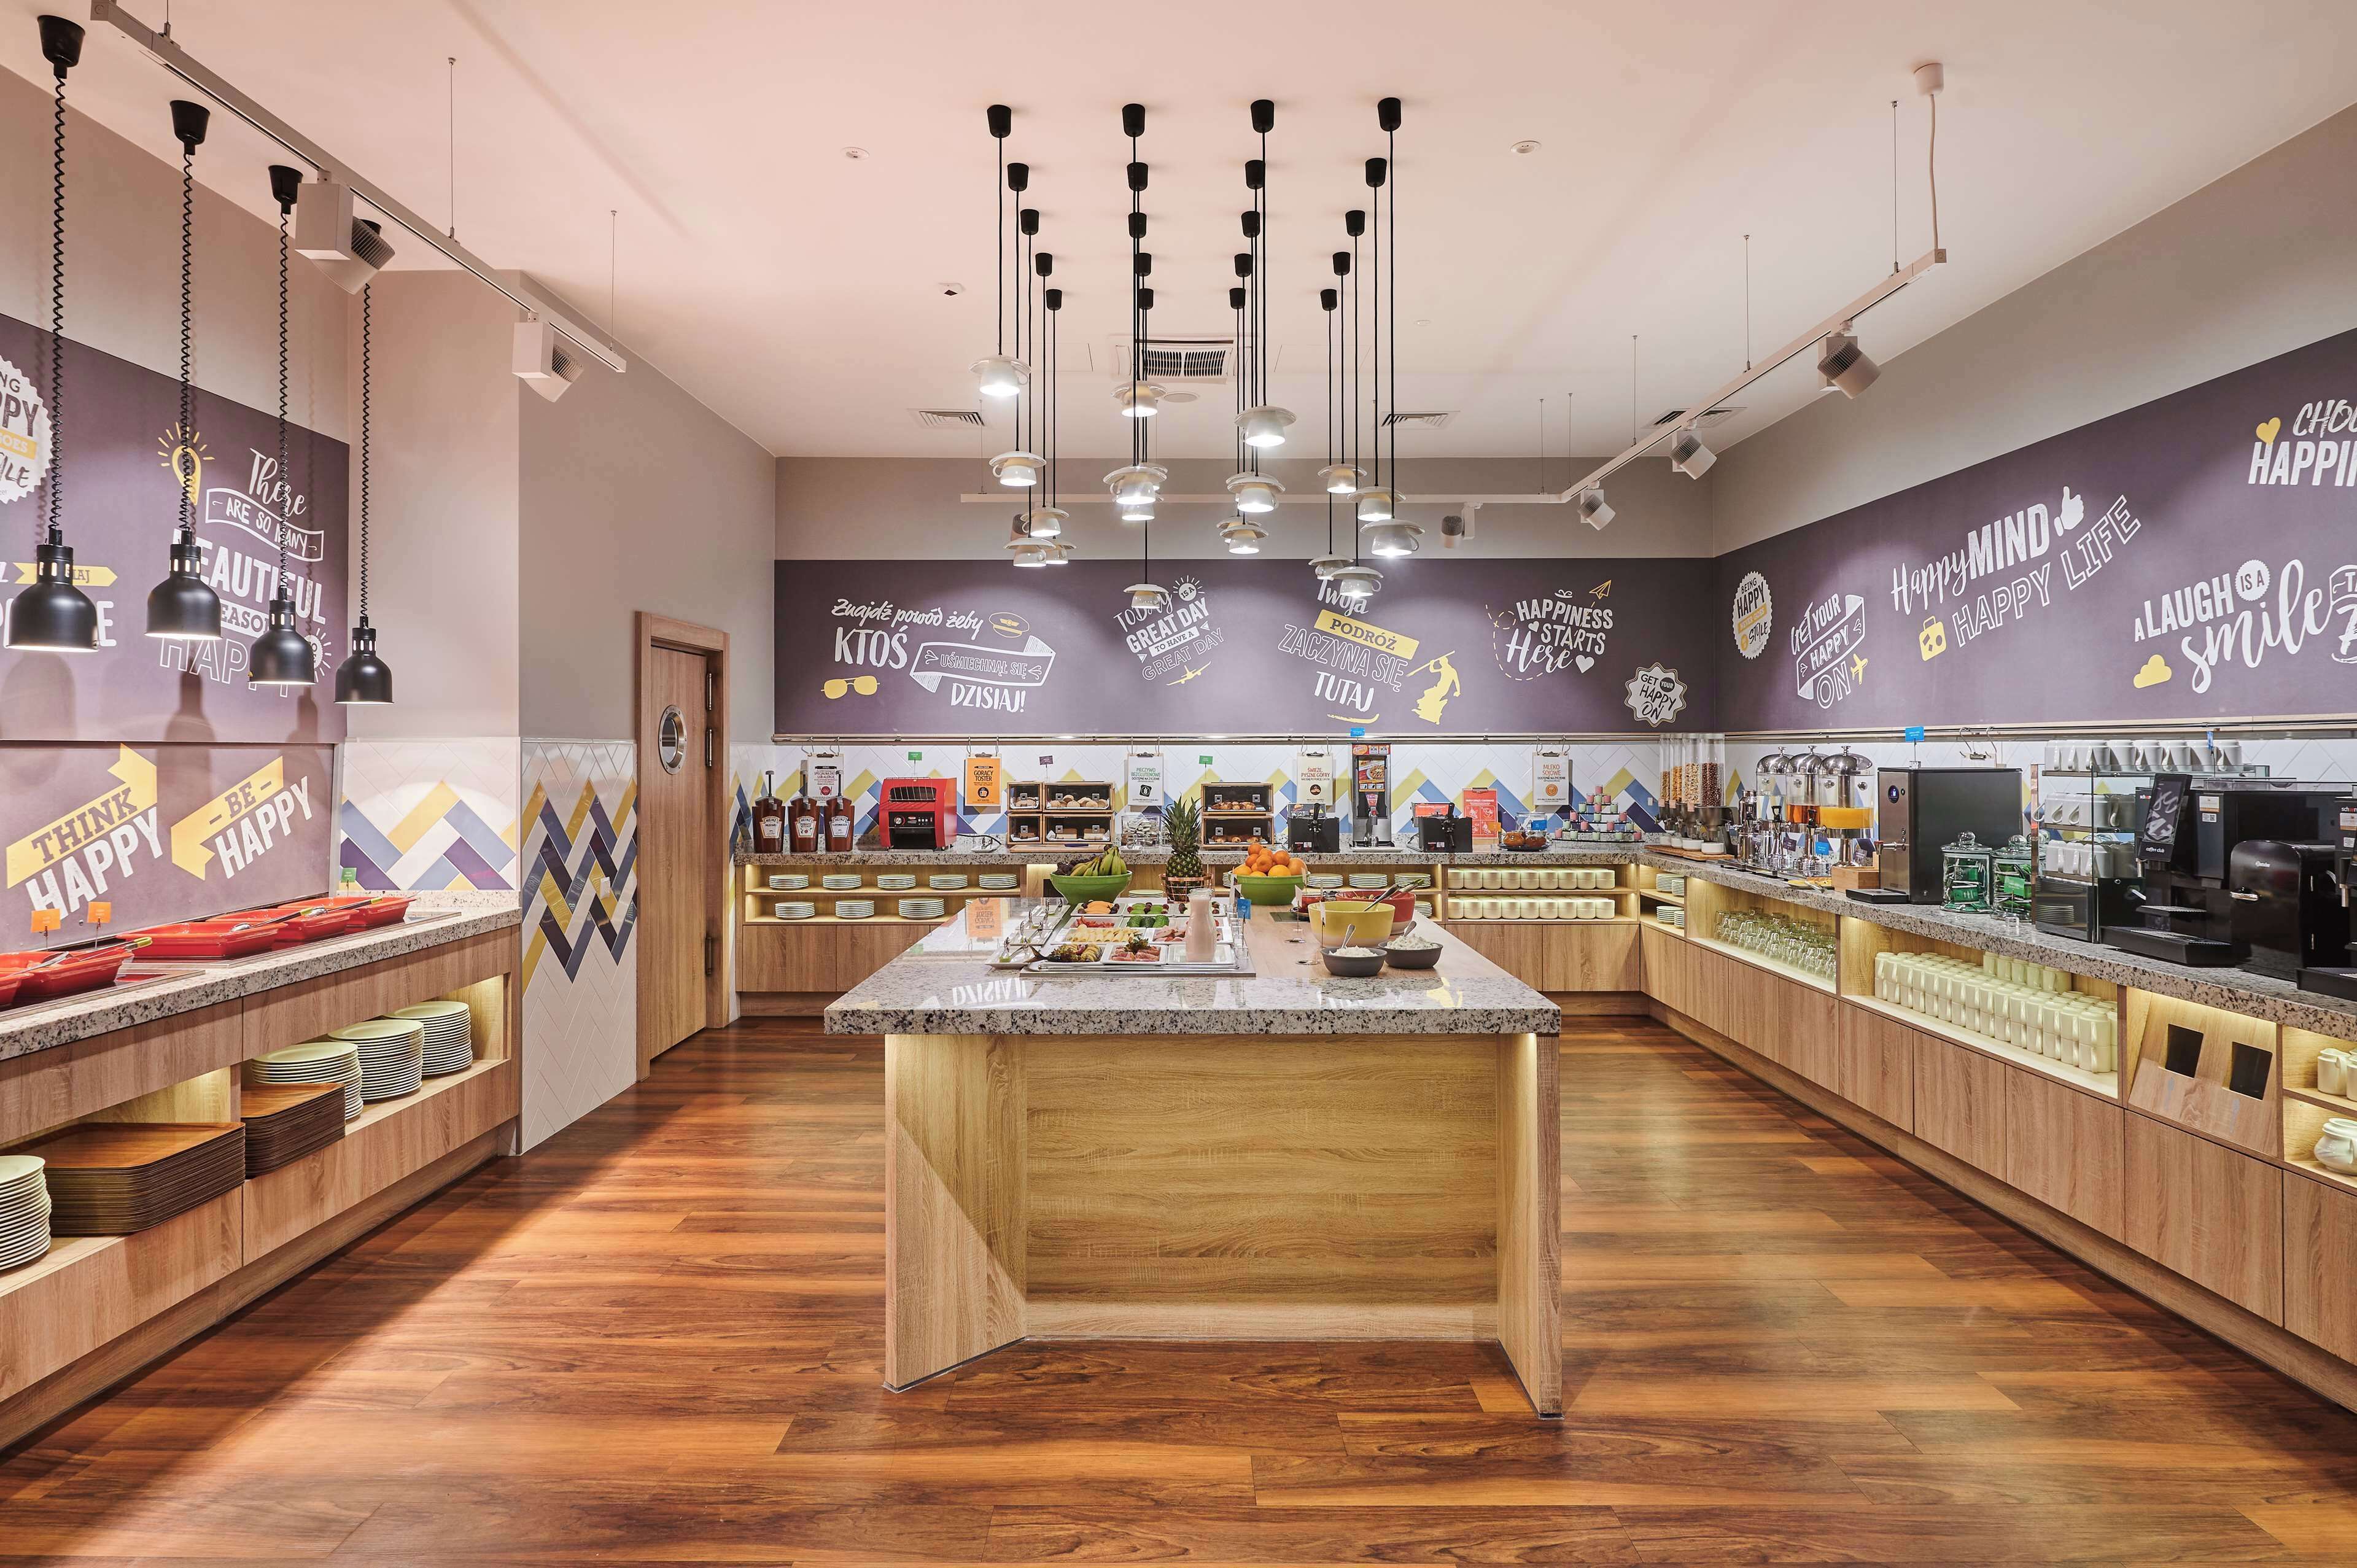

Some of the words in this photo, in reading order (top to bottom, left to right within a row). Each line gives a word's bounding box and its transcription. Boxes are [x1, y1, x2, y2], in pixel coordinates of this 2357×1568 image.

[0, 434, 28, 453] OES
[249, 447, 307, 517] There
[226, 498, 250, 525] ARE
[256, 510, 271, 532] SO
[274, 526, 308, 557] MANY
[173, 529, 326, 624] EAUTIFUL
[1891, 549, 1970, 615] Happy
[1967, 503, 2049, 580] MIND
[1953, 562, 2052, 647] HAPPY
[2061, 495, 2141, 590] LIFE
[1181, 589, 1188, 599] IS
[1737, 581, 1765, 619] HAPPY
[1741, 578, 1757, 594] BEING
[2240, 575, 2252, 592] IS
[2256, 570, 2265, 587] A
[832, 598, 894, 625] Znajdź
[892, 608, 944, 631] powód
[946, 609, 984, 640] żeby
[1126, 613, 1179, 653] GREAT
[1179, 597, 1210, 625] DAY
[1516, 599, 1613, 629] HAPPINESS
[1812, 593, 1842, 631] YOUR
[2135, 618, 2145, 642] A
[2145, 573, 2234, 638] LAUGH
[2181, 559, 2332, 693] smile
[834, 624, 908, 669] KTOŚ
[1142, 647, 1191, 681] GREAT
[1194, 627, 1225, 655] DAY
[1154, 643, 1165, 653] TO
[1167, 635, 1186, 649] HAVE
[1187, 631, 1195, 640] A
[1329, 618, 1399, 651] PODRÓŻ
[1505, 629, 1574, 673] Here
[1540, 624, 1606, 655] STARTS
[1749, 622, 1768, 645] STYLE
[1810, 625, 1850, 670] HAPPY
[160, 637, 288, 697] HAP
[941, 651, 1008, 677] UŚMIECHNĄŁ
[1010, 662, 1028, 679] SIĘ
[1278, 624, 1370, 675] ZACZYNA
[1372, 653, 1408, 693] SIĘ
[951, 683, 1027, 713] DZISIAJ!
[1314, 671, 1375, 712] TUTAJ
[1640, 686, 1677, 712] HAPPY
[1641, 674, 1659, 686] GET
[1660, 680, 1674, 690] YOUR
[1817, 661, 1852, 708] ON
[1641, 702, 1663, 720] ON
[225, 782, 256, 818] BE
[31, 787, 137, 863] THINK
[216, 776, 312, 879] HAPPY
[26, 807, 163, 920] HAPPY
